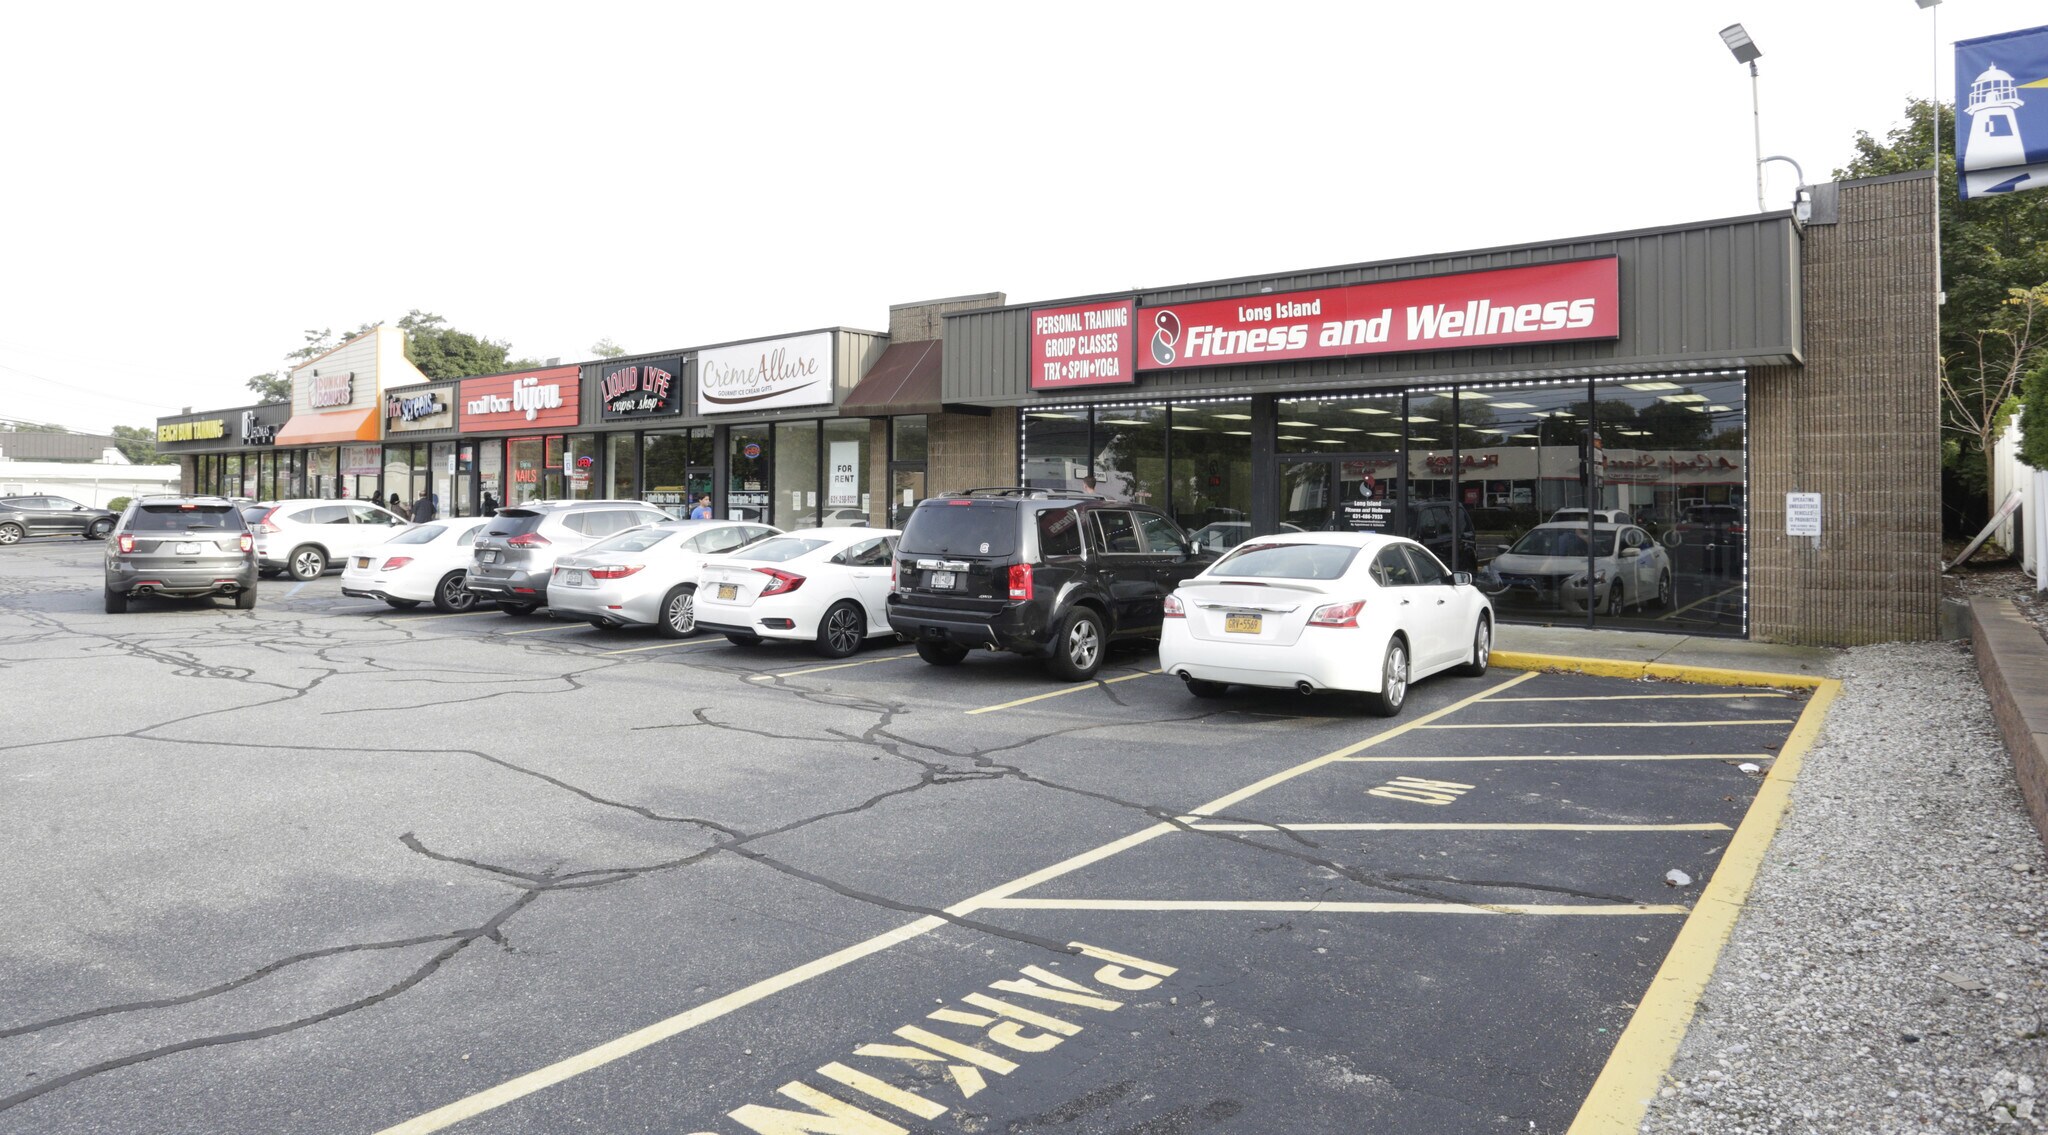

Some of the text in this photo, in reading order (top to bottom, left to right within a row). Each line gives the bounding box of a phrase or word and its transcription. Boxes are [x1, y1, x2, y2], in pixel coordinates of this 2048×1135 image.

[1036, 307, 1128, 335] PERSONAL TRAINING
[1238, 298, 1321, 322] Long Island
[1184, 297, 1596, 358] Fitness and Wellness
[1045, 333, 1119, 358] GROUP CLASSES
[1043, 362, 1061, 381] TRX
[600, 365, 672, 403] LIQUID LYFE
[718, 389, 738, 397] GOURMET
[745, 387, 761, 396] CREAM
[513, 377, 563, 421] bijou
[612, 394, 659, 415] vapor shop
[158, 419, 225, 443] BEACH BUM TANNING
[514, 469, 537, 483] NAILS
[834, 474, 854, 483] RENT
[837, 464, 852, 473] FOR
[1366, 776, 1477, 805] NO
[686, 941, 1179, 1135] PARKIN
